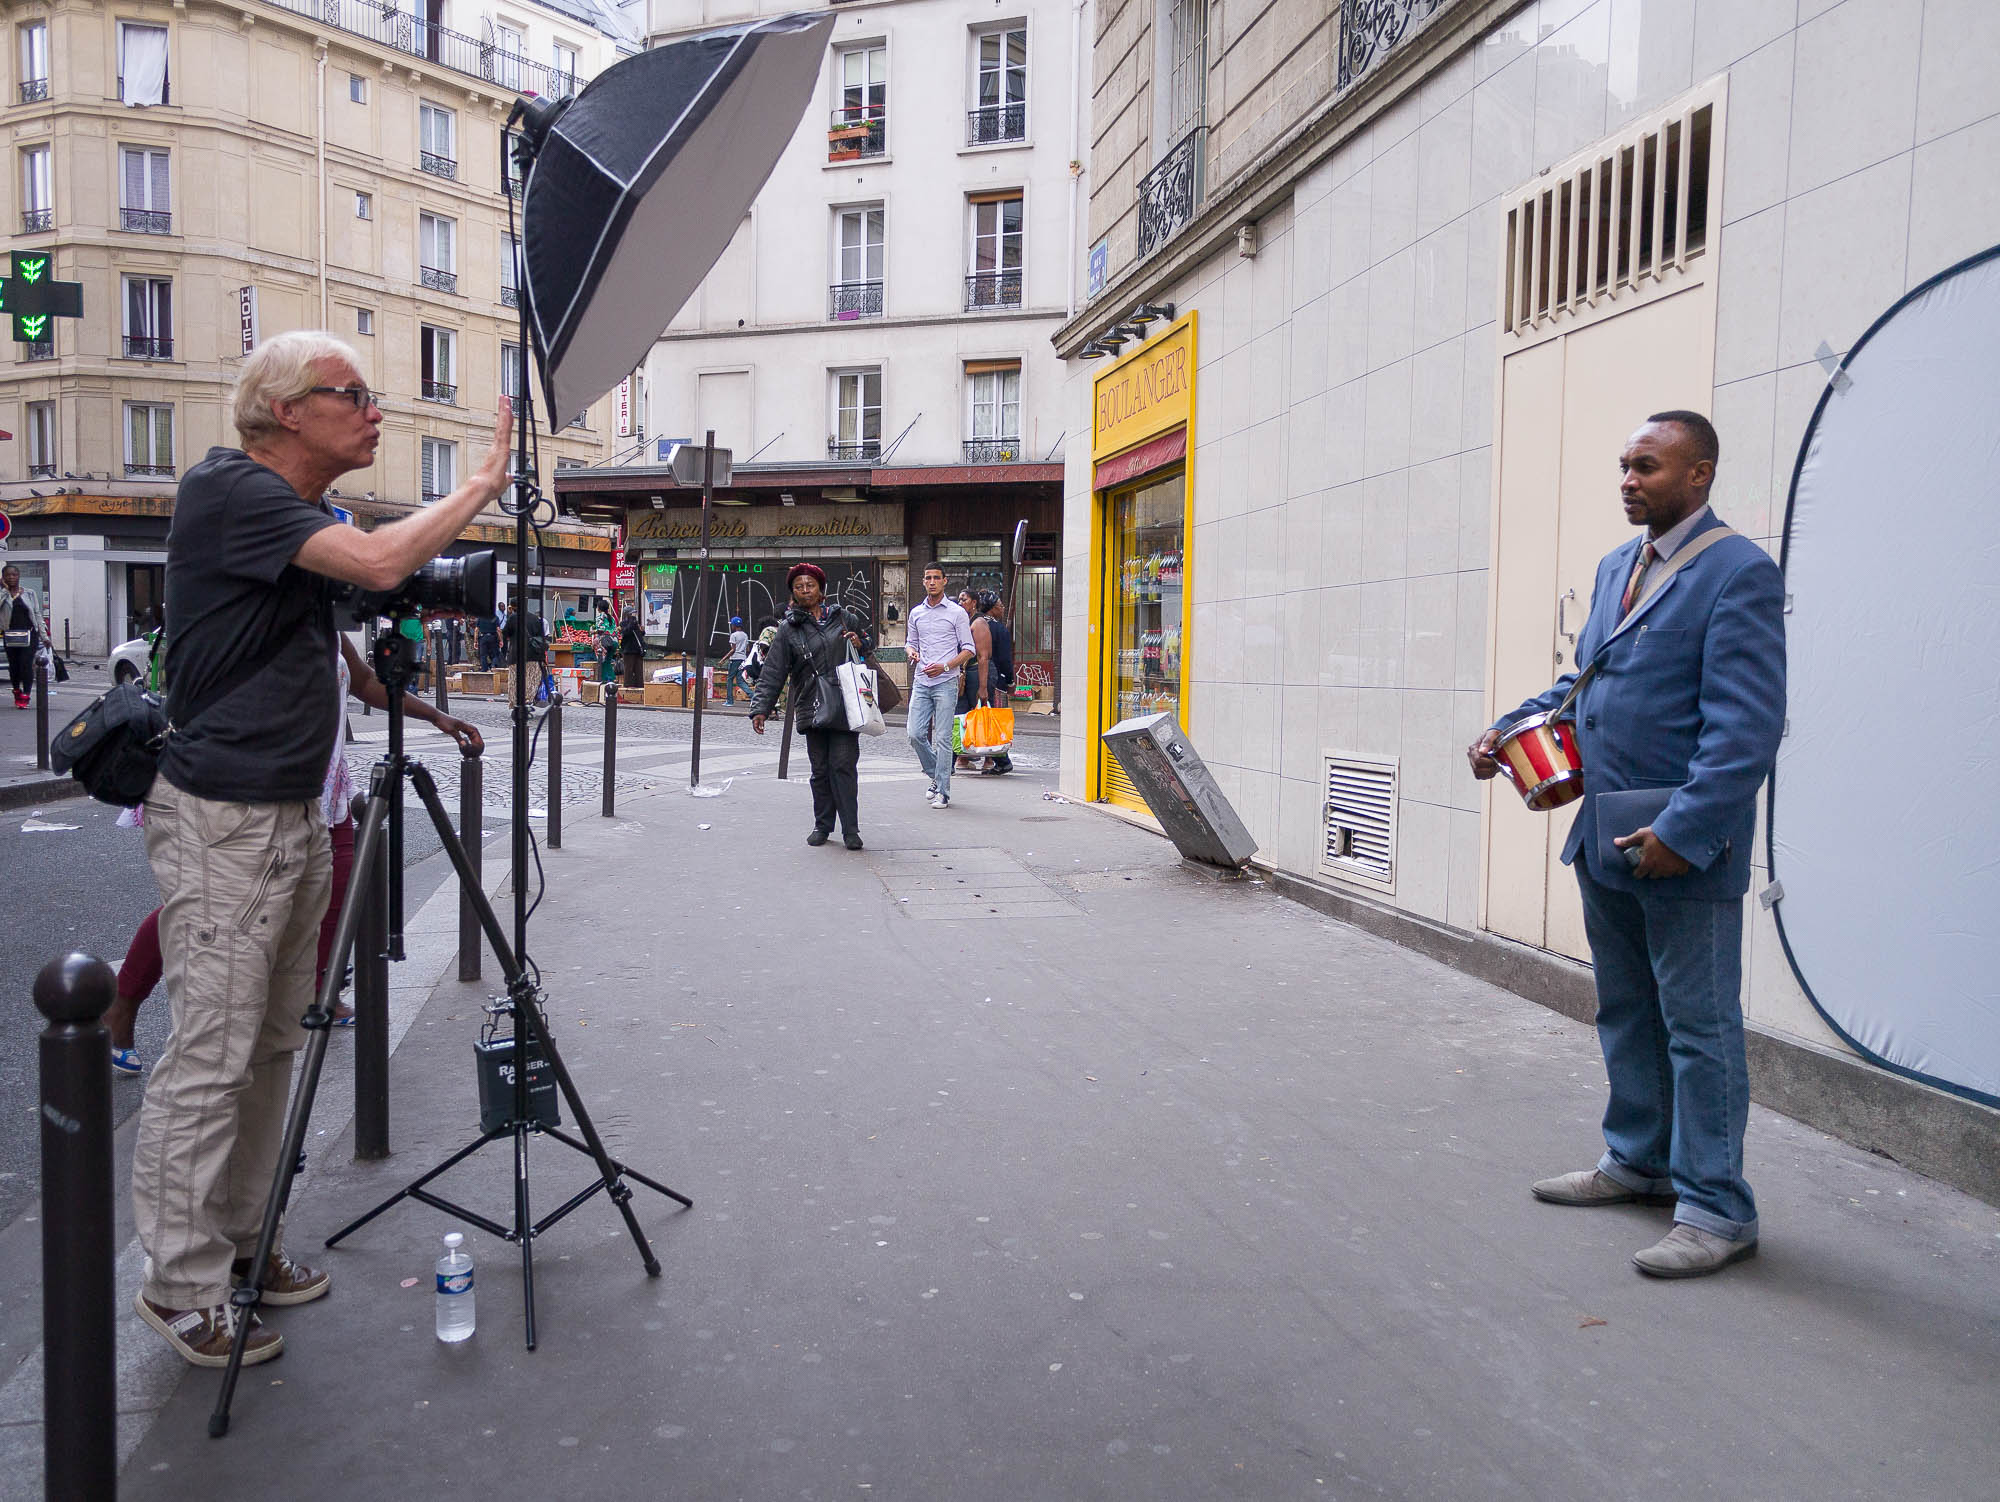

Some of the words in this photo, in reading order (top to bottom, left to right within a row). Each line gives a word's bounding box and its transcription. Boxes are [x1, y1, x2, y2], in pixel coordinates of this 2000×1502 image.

[241, 288, 253, 355] HOTEL
[1099, 347, 1187, 432] BOULANGER
[778, 516, 872, 536] comestibles
